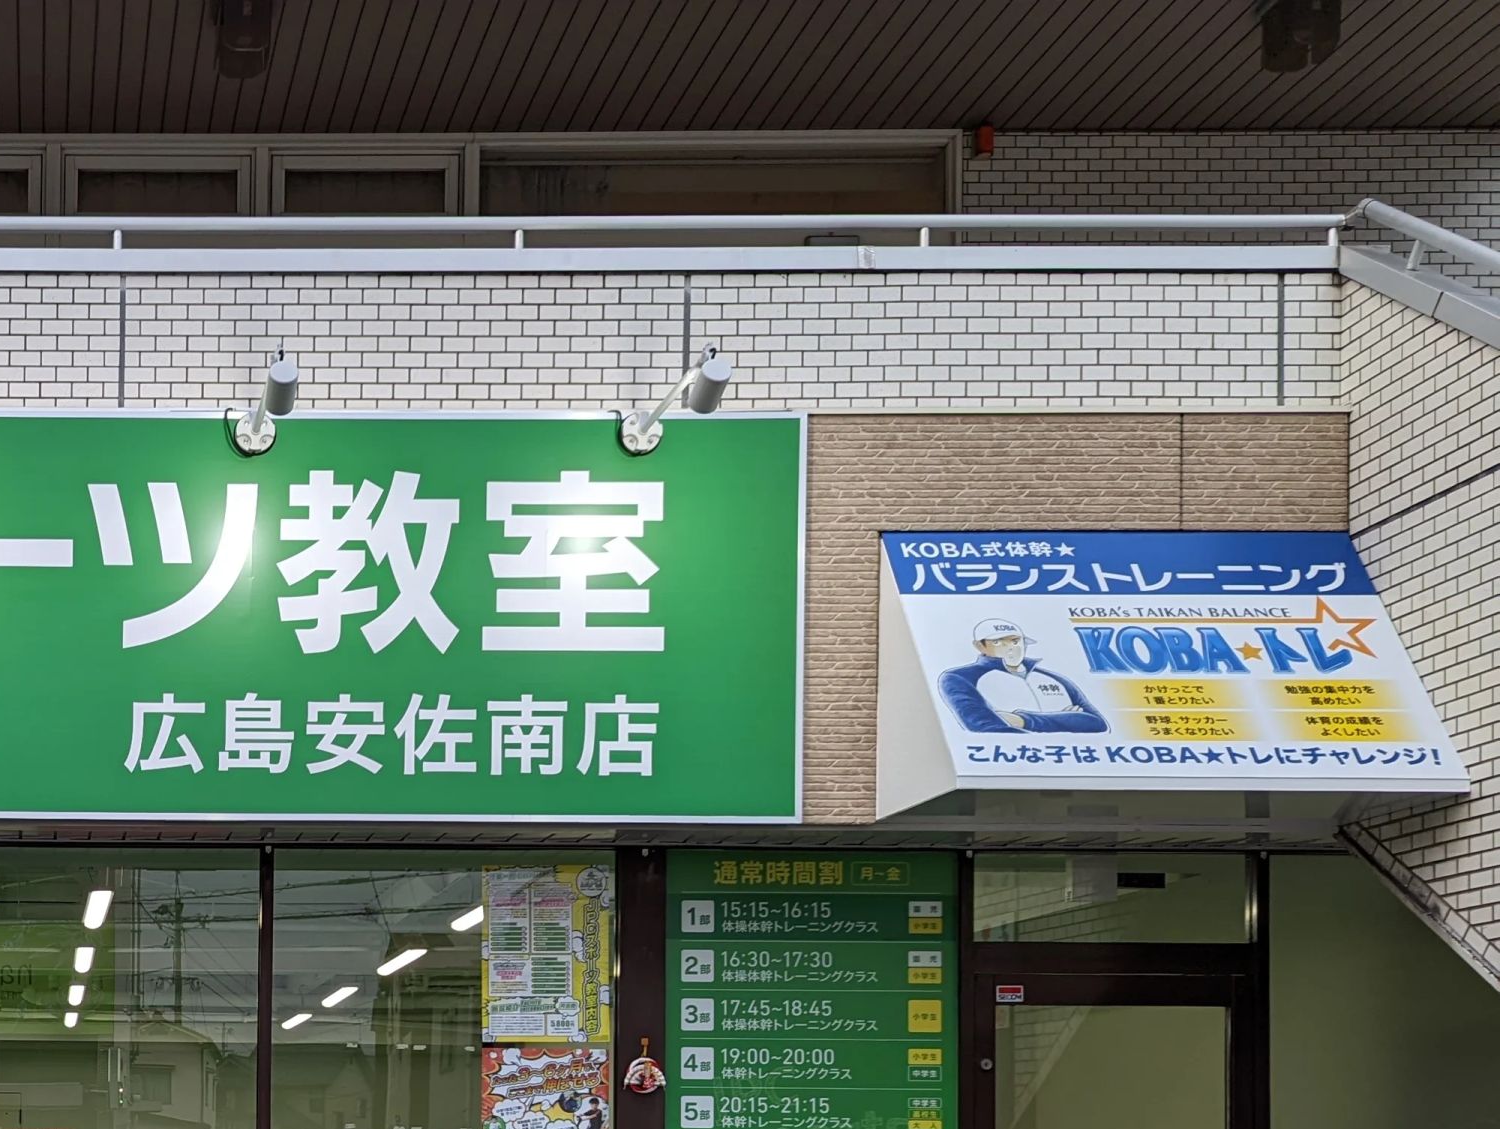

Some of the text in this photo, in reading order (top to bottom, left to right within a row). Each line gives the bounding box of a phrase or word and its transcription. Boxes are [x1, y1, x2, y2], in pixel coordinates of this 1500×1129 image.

[913, 561, 1346, 593] バランストレーニング
[1134, 608, 1202, 617] TAIKAN
[1208, 608, 1291, 618] BALANCE
[993, 624, 1016, 632] KOBA
[1144, 685, 1204, 694] かけっこで
[1284, 685, 1375, 694] 勉強の集中力を
[1144, 696, 1215, 705] 1番とりたい
[1310, 697, 1361, 705] 高めたい
[1305, 716, 1384, 725] 体育の成績を
[124, 692, 659, 776] 広島安佐南店
[1149, 727, 1234, 736] うまくなりたい
[1321, 727, 1381, 736] よくしたい
[713, 861, 843, 885] 通常時間割
[722, 920, 878, 933] 体操体幹トレーニングクラス
[721, 970, 878, 983] 体操体幹トレーニングクラス
[721, 1019, 878, 1032] 体操体幹トレーニングクラス
[721, 1067, 852, 1080] 体幹トレーニングクラス
[721, 1116, 852, 1129] 体幹トレーニングクラス
